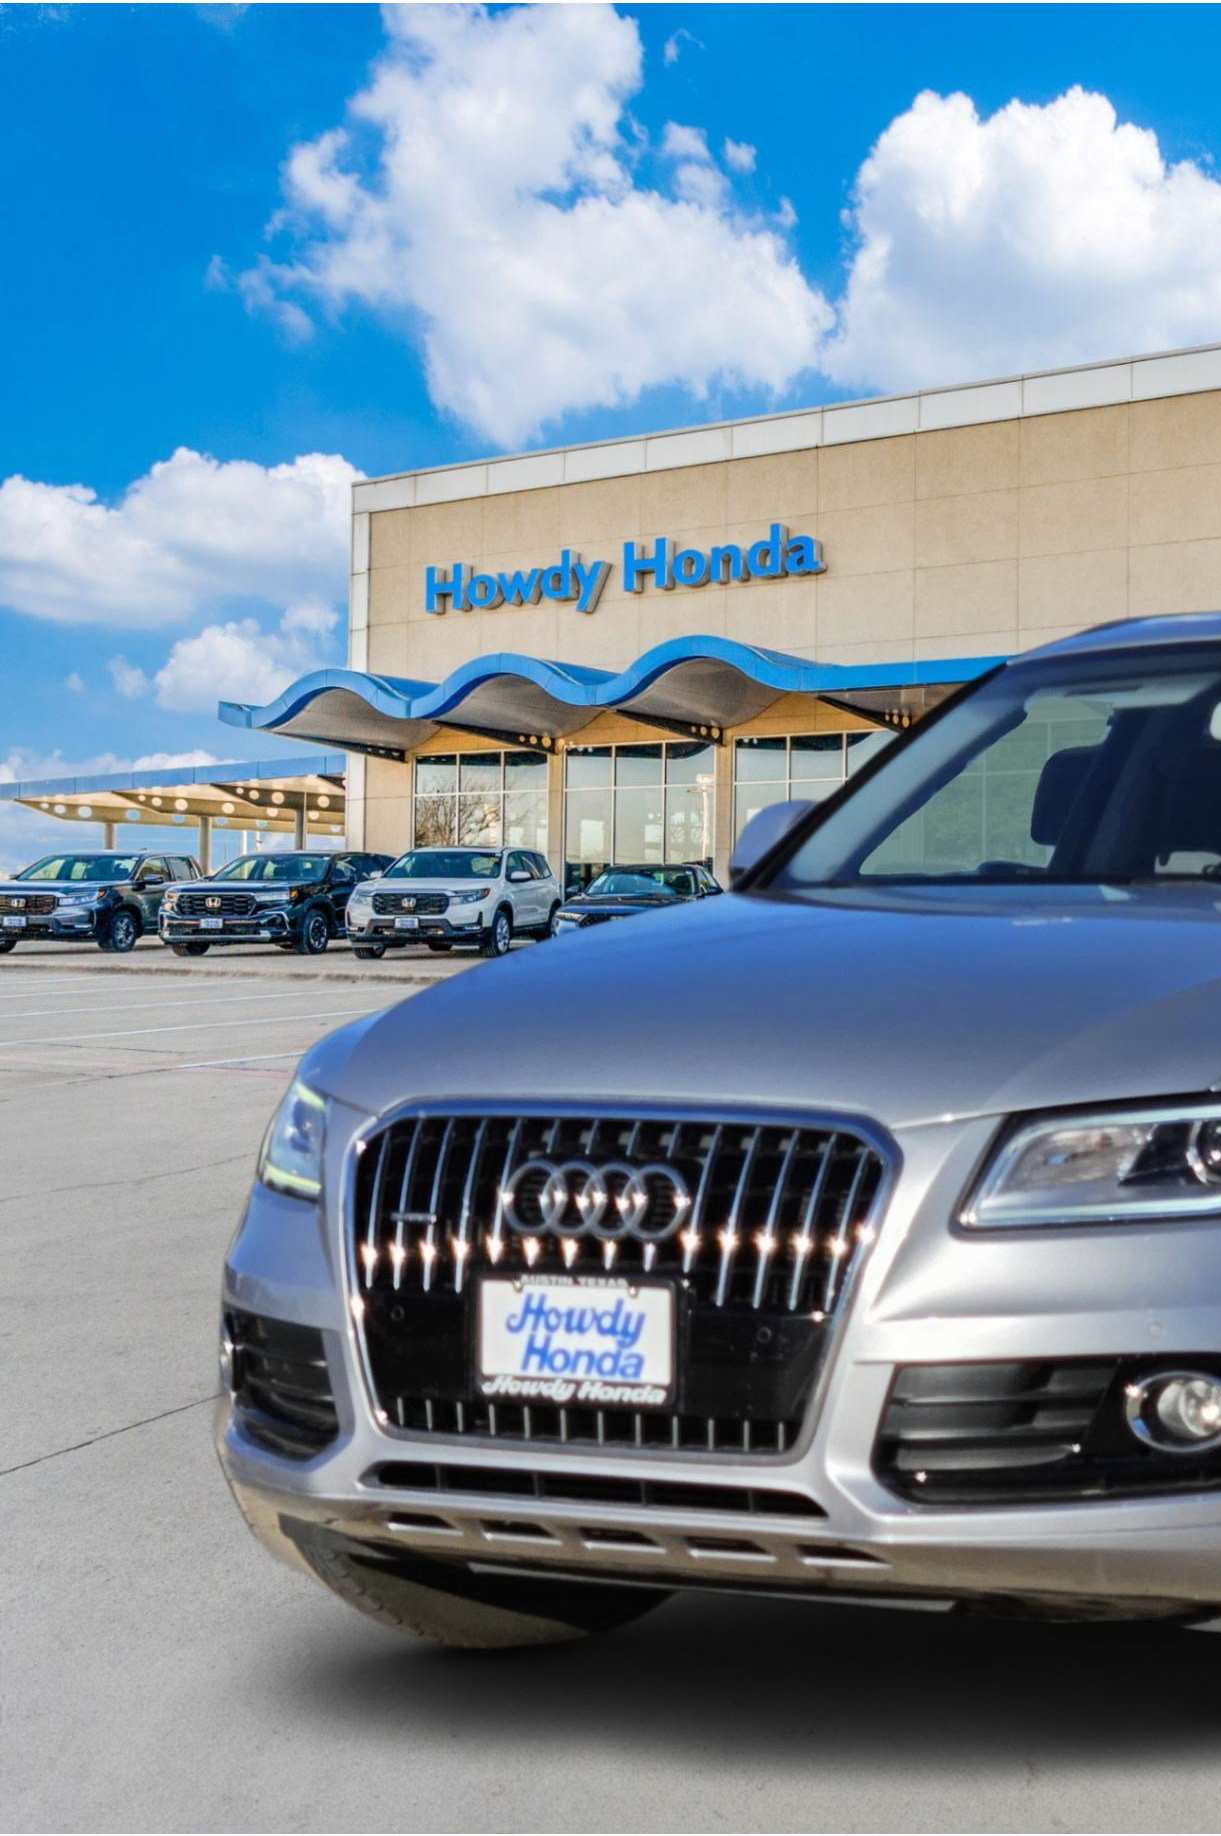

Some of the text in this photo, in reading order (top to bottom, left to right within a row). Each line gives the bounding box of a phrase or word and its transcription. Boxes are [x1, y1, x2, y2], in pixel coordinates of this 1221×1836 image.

[425, 522, 827, 615] Howdy Honda
[505, 1293, 646, 1349] Howdy
[521, 1332, 645, 1381] Honda
[480, 1375, 667, 1404] Howdy Honda
